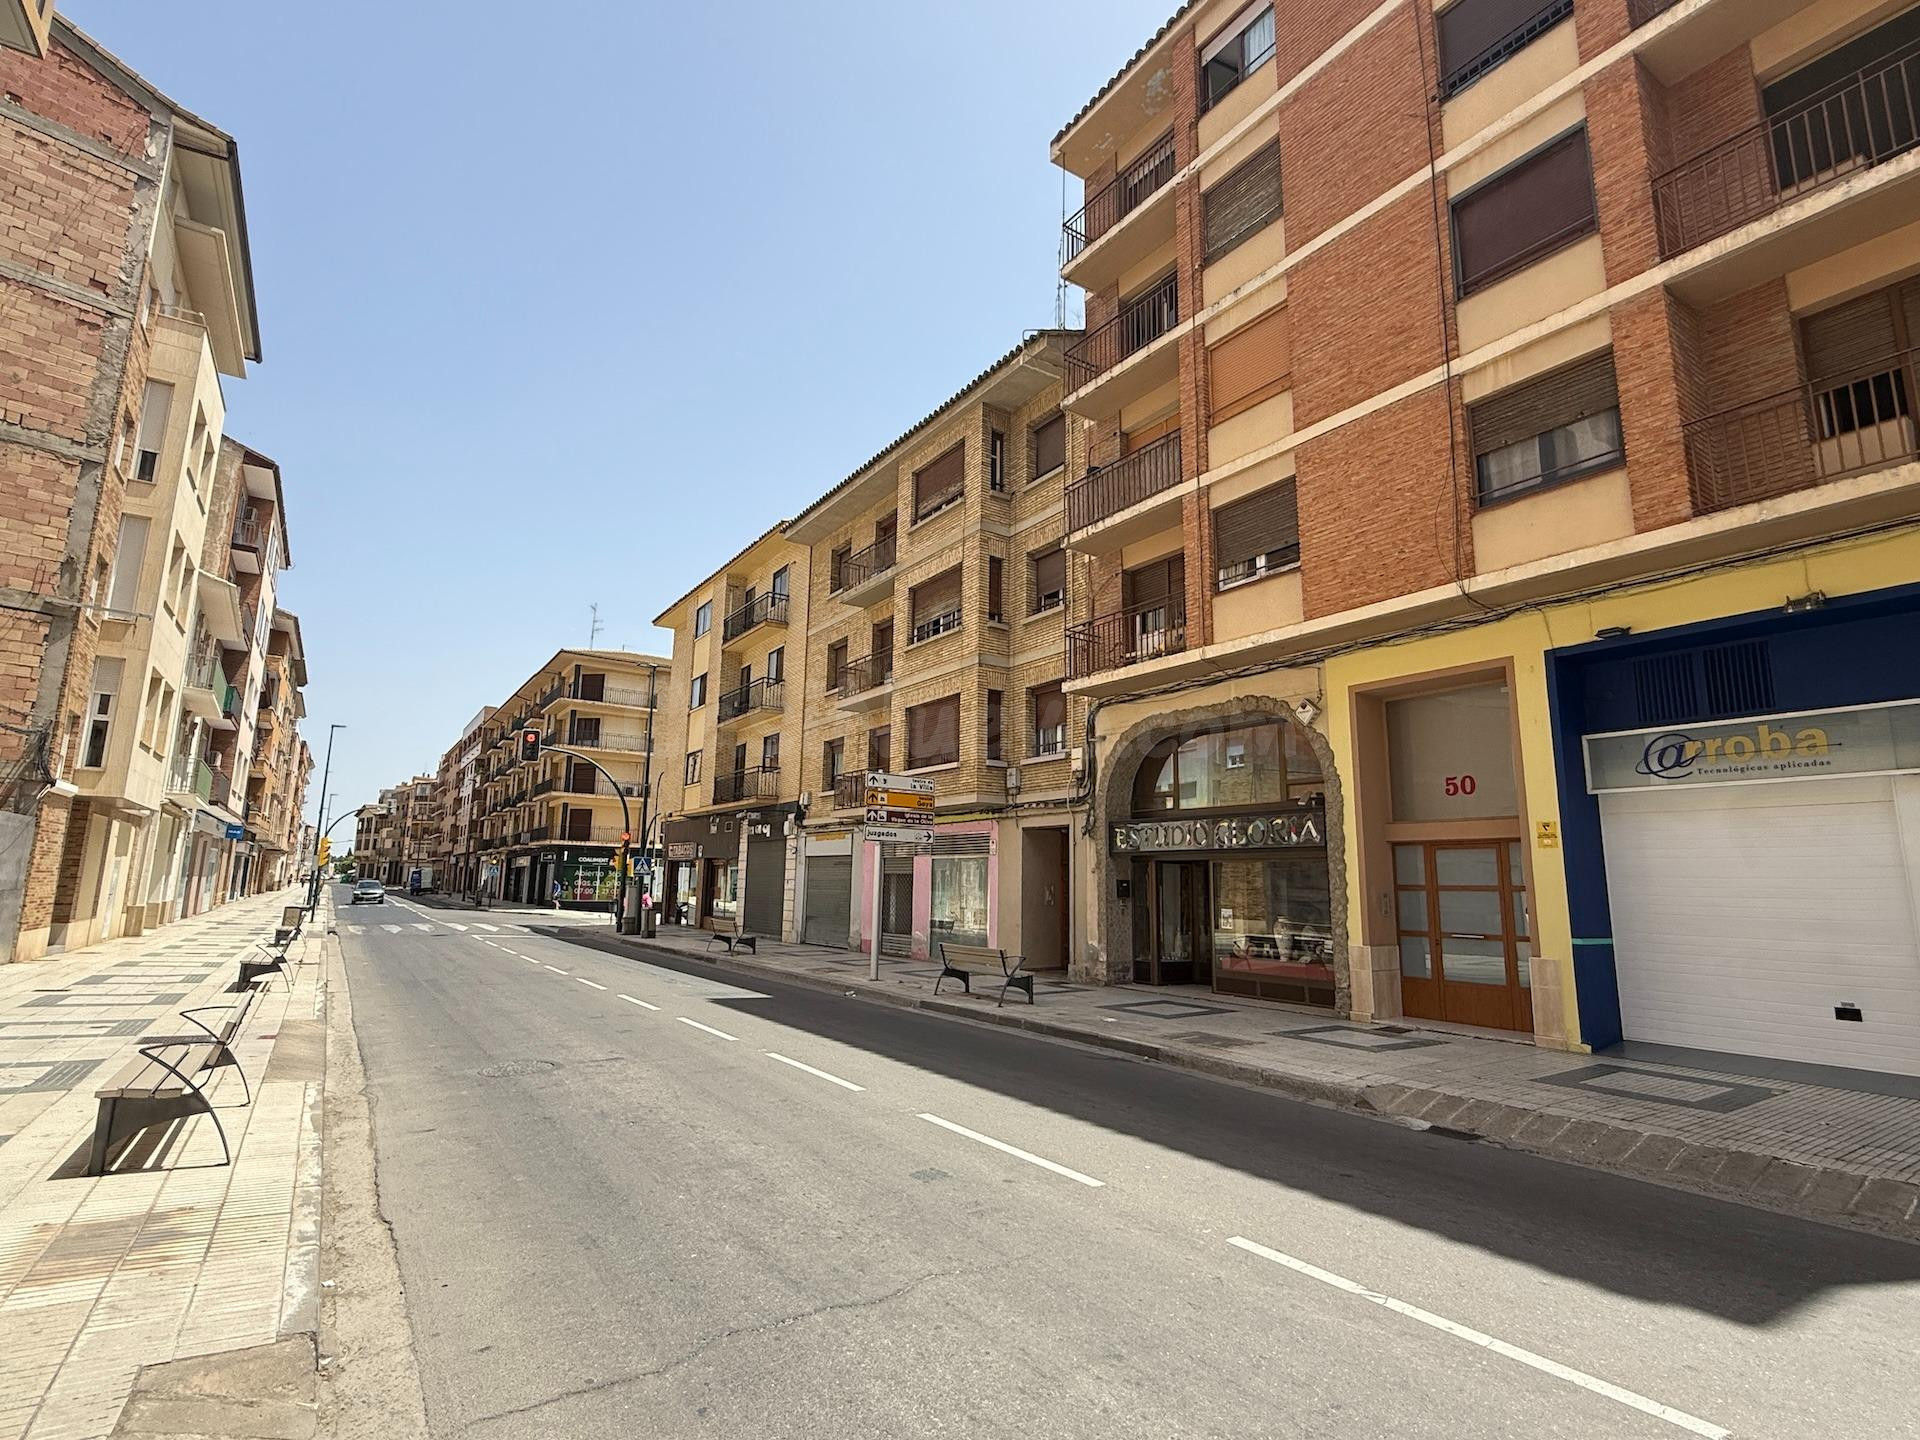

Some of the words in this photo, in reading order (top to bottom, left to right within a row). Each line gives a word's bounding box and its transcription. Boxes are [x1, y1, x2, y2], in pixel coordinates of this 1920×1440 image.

[1772, 759, 1832, 771] aplicadas
[1445, 775, 1476, 796] 50
[916, 800, 933, 808] Goya
[1114, 820, 1209, 849] ESTUDIO
[1214, 812, 1321, 848] GLORIA
